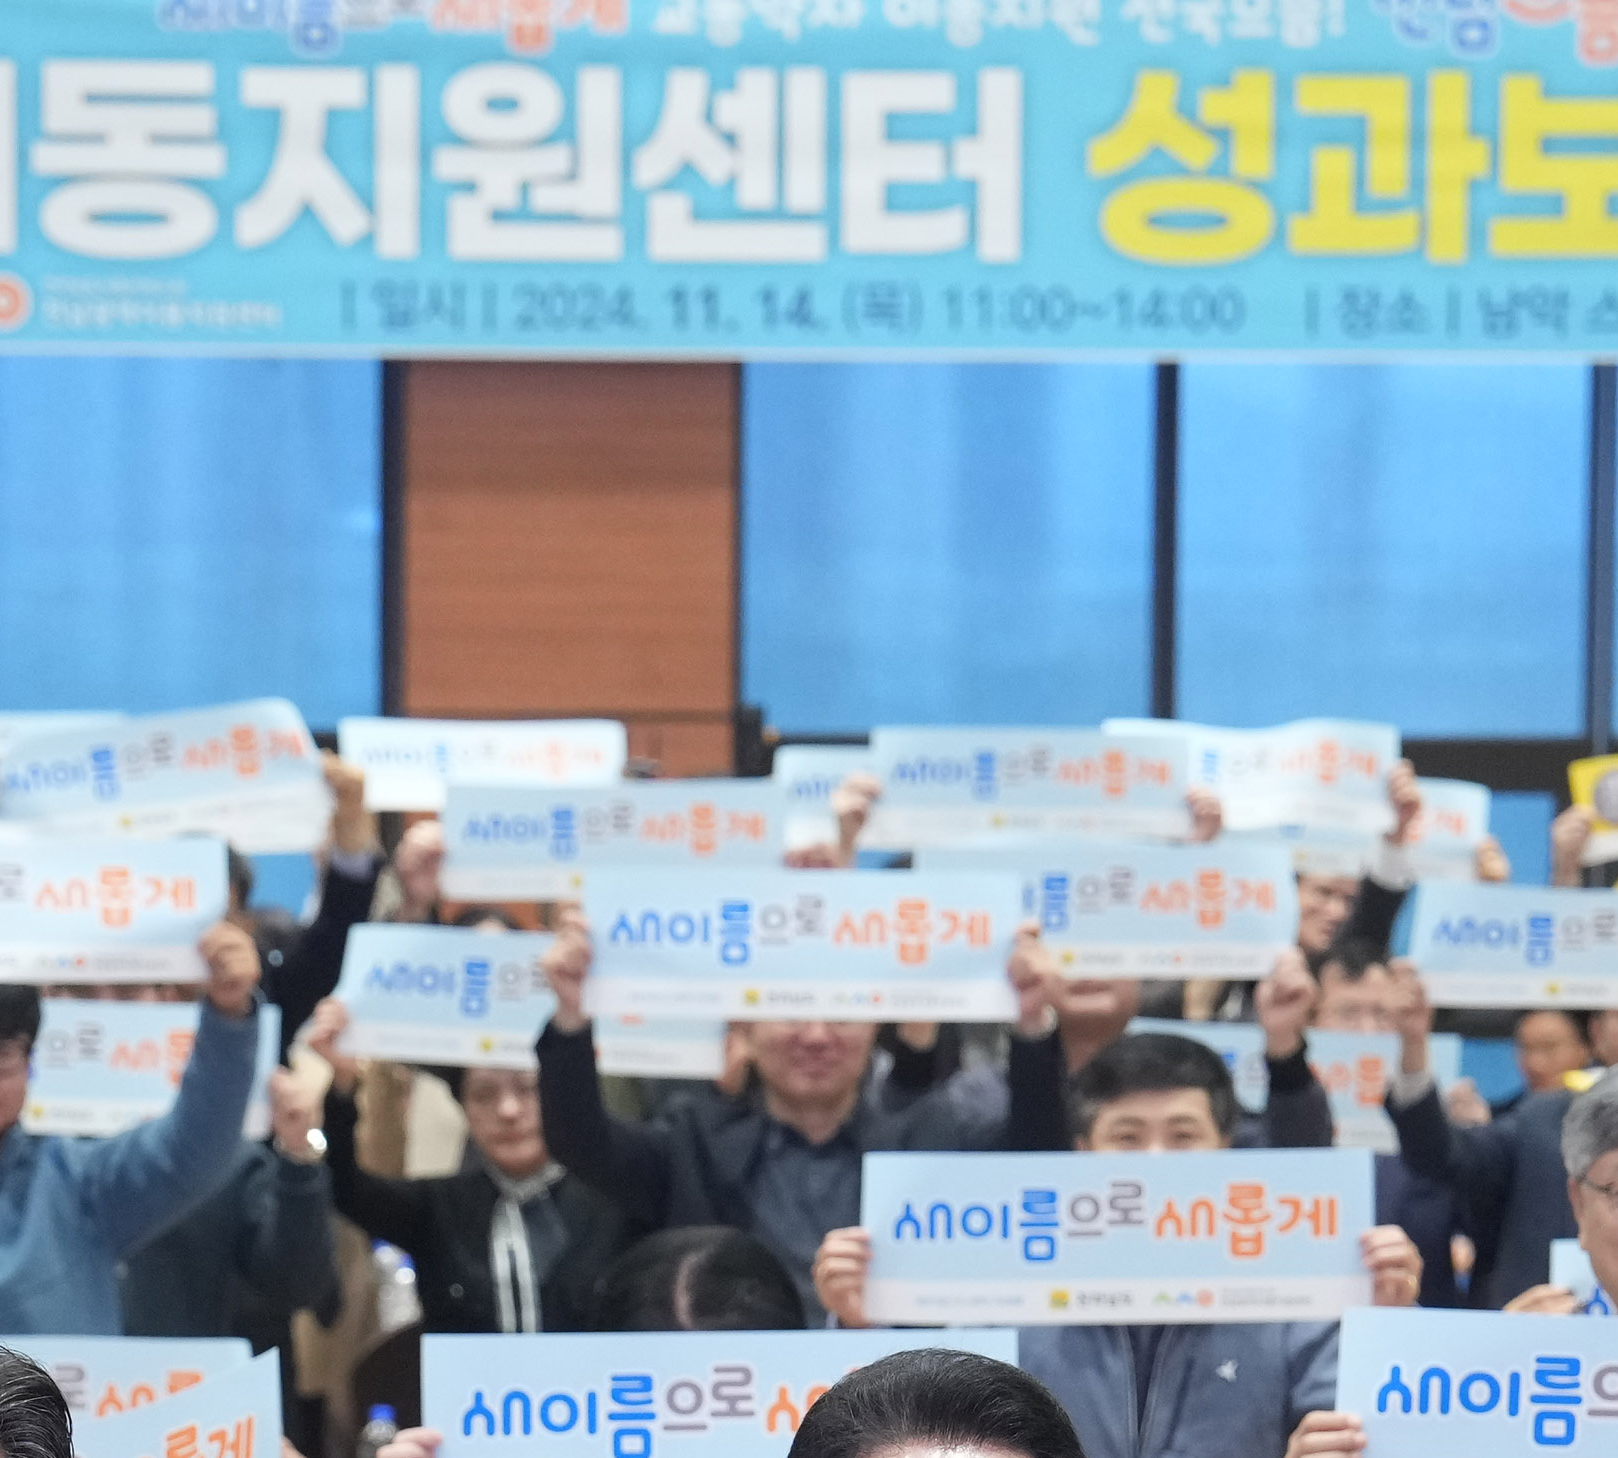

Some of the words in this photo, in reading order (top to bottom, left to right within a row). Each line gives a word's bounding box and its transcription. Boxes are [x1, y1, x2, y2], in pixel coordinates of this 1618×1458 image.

[34, 864, 198, 929] 새롭게
[1139, 869, 1275, 929] 새롭게
[609, 896, 826, 967] 새이름으로
[832, 898, 993, 966] 새롭게
[894, 1180, 1148, 1262] 새이름으로
[1152, 1181, 1339, 1259] 새롭게
